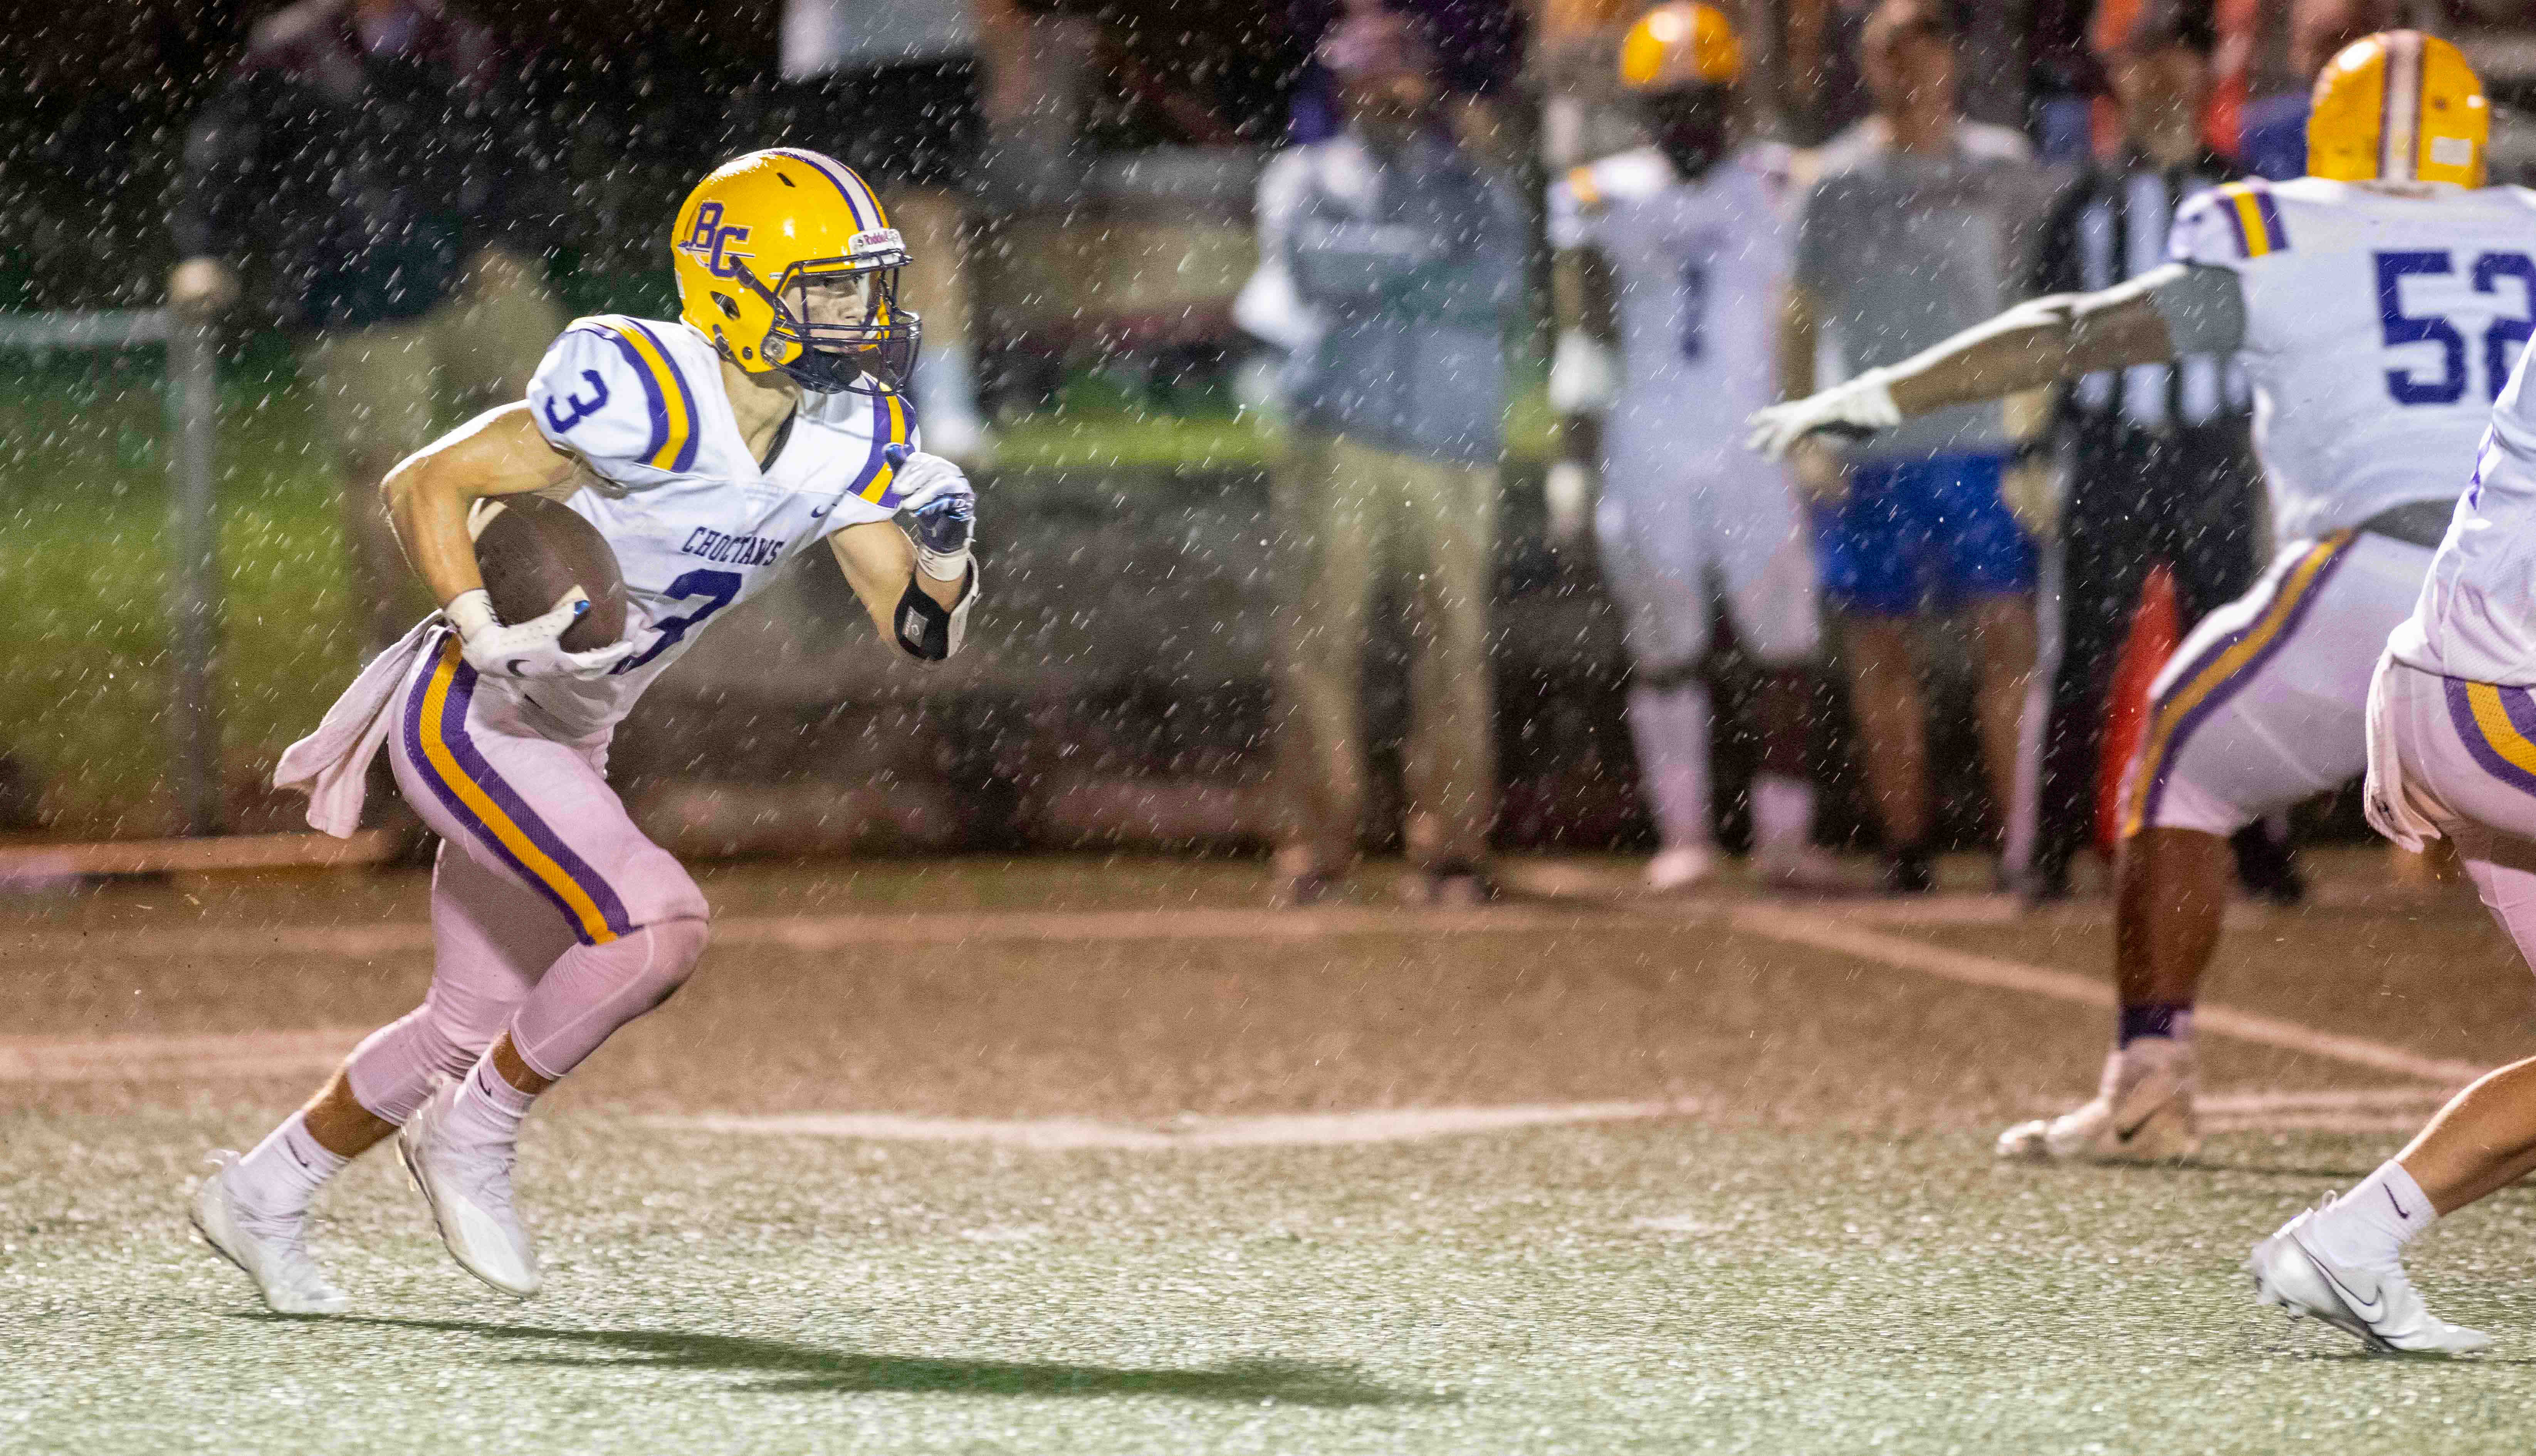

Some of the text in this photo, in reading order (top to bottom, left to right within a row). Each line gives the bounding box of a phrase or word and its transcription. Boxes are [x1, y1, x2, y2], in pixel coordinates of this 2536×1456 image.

[691, 201, 750, 278] BC
[2375, 250, 2536, 406] 52
[544, 369, 609, 434] 3
[682, 526, 785, 567] CHOCTAWS
[606, 568, 743, 676] 3
